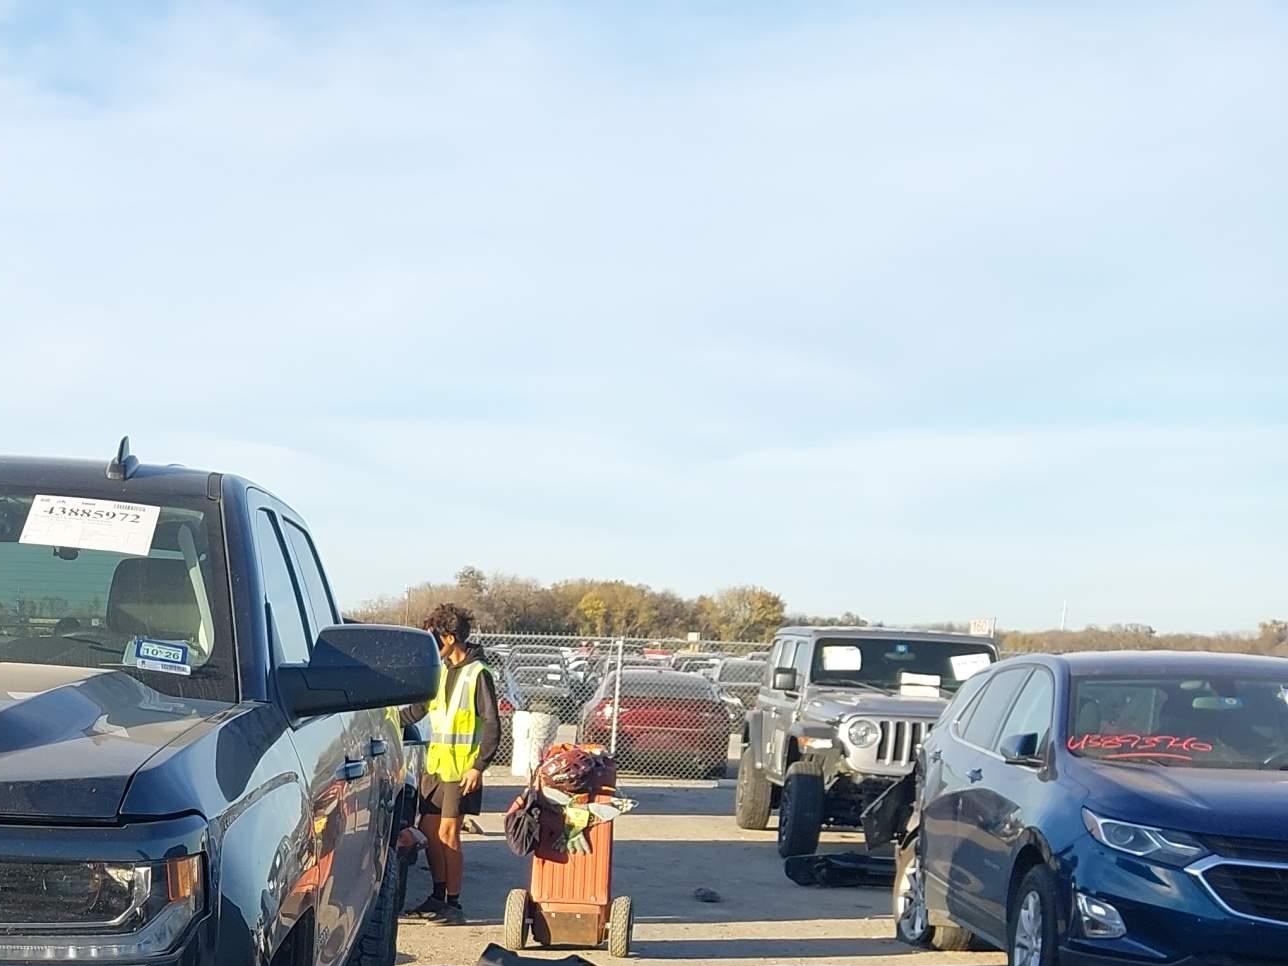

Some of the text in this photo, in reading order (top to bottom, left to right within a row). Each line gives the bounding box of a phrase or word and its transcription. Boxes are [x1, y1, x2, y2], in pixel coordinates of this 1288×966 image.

[43, 505, 141, 524] 43885972
[144, 647, 159, 656] 10
[165, 651, 180, 660] 26
